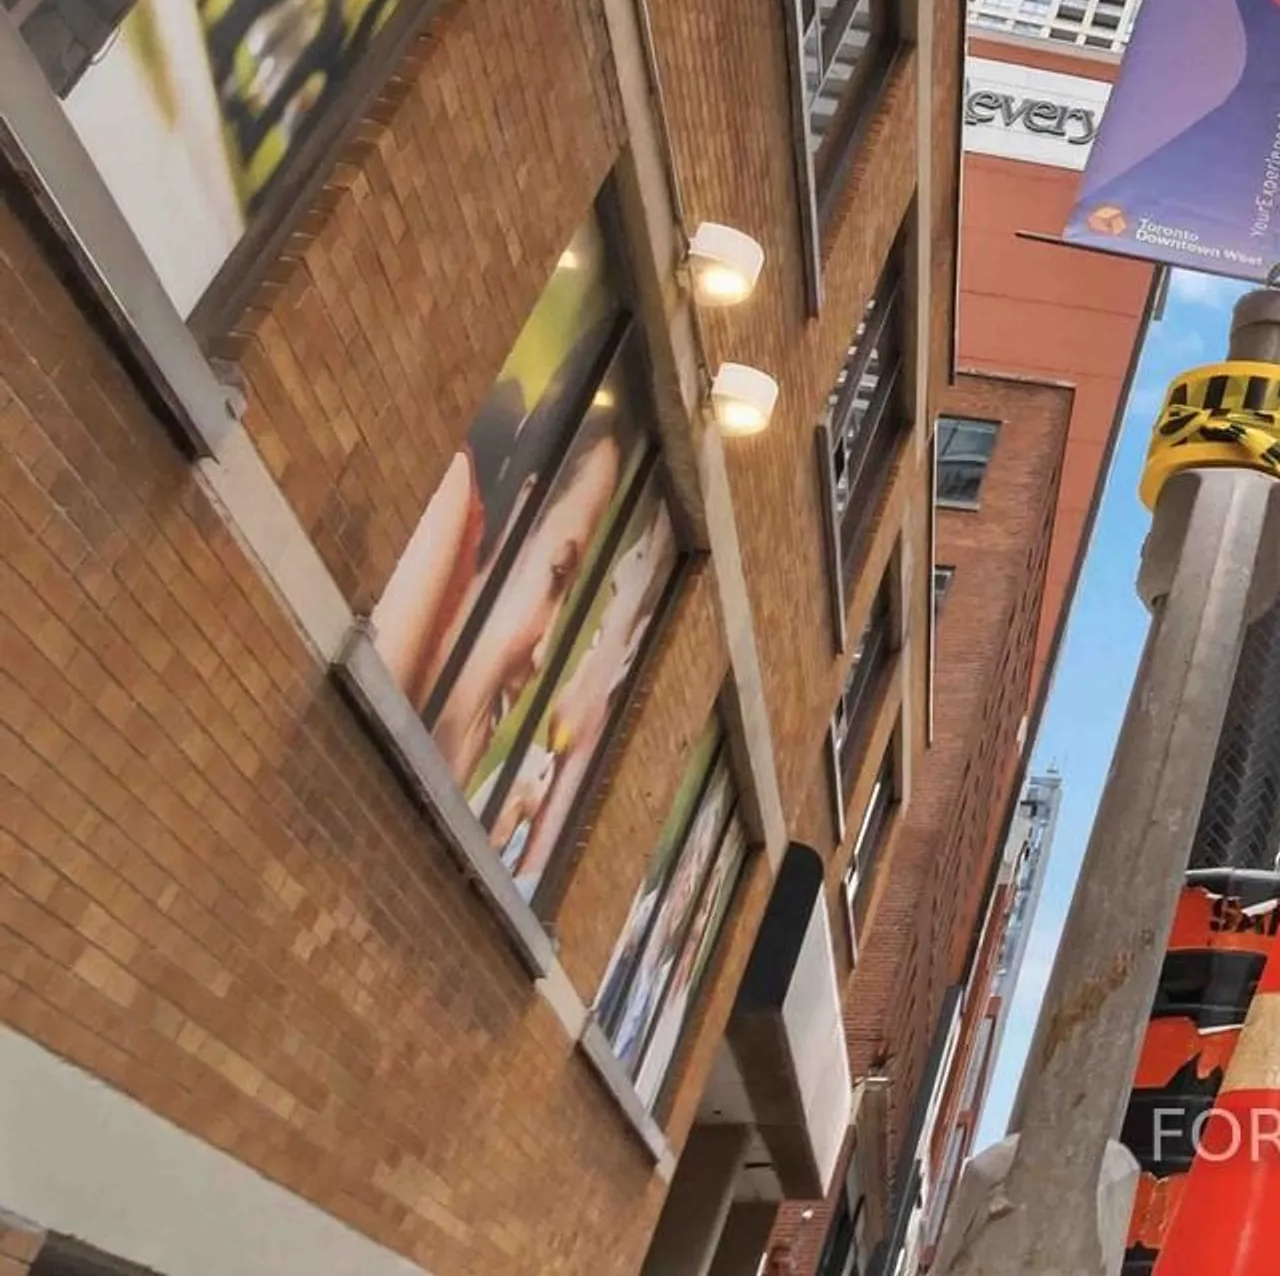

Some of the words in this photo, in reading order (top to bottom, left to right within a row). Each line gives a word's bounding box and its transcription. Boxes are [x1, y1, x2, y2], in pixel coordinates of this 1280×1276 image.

[1138, 217, 1200, 242] Toronto
[1135, 228, 1221, 259] Downtown
[1222, 246, 1264, 267] West
